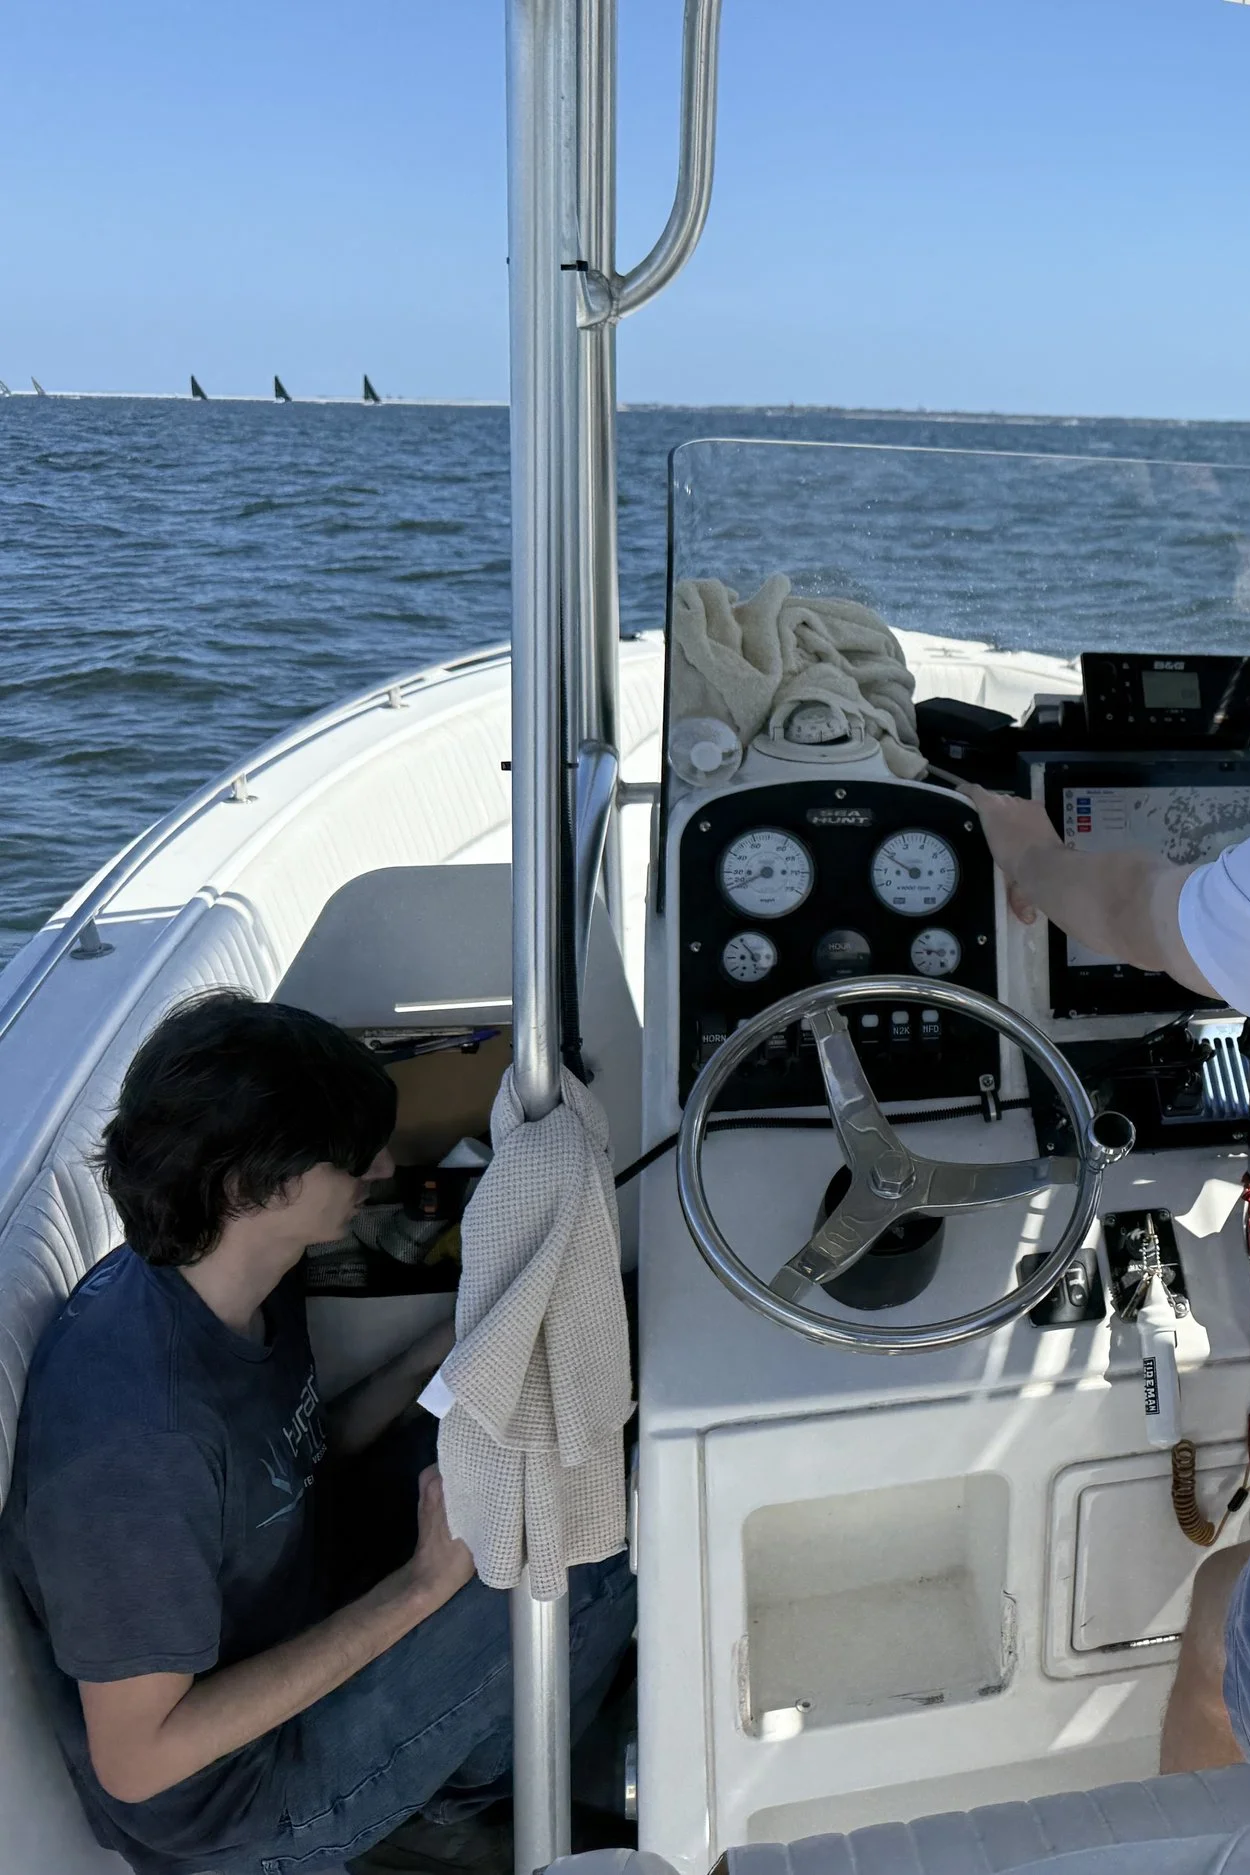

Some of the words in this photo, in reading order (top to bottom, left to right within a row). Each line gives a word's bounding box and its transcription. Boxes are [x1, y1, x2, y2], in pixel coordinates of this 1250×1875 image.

[893, 1026, 910, 1035] N2K
[922, 1024, 939, 1033] MFD
[702, 1034, 727, 1043] HORN
[1144, 1359, 1159, 1413] TIDEMAN
